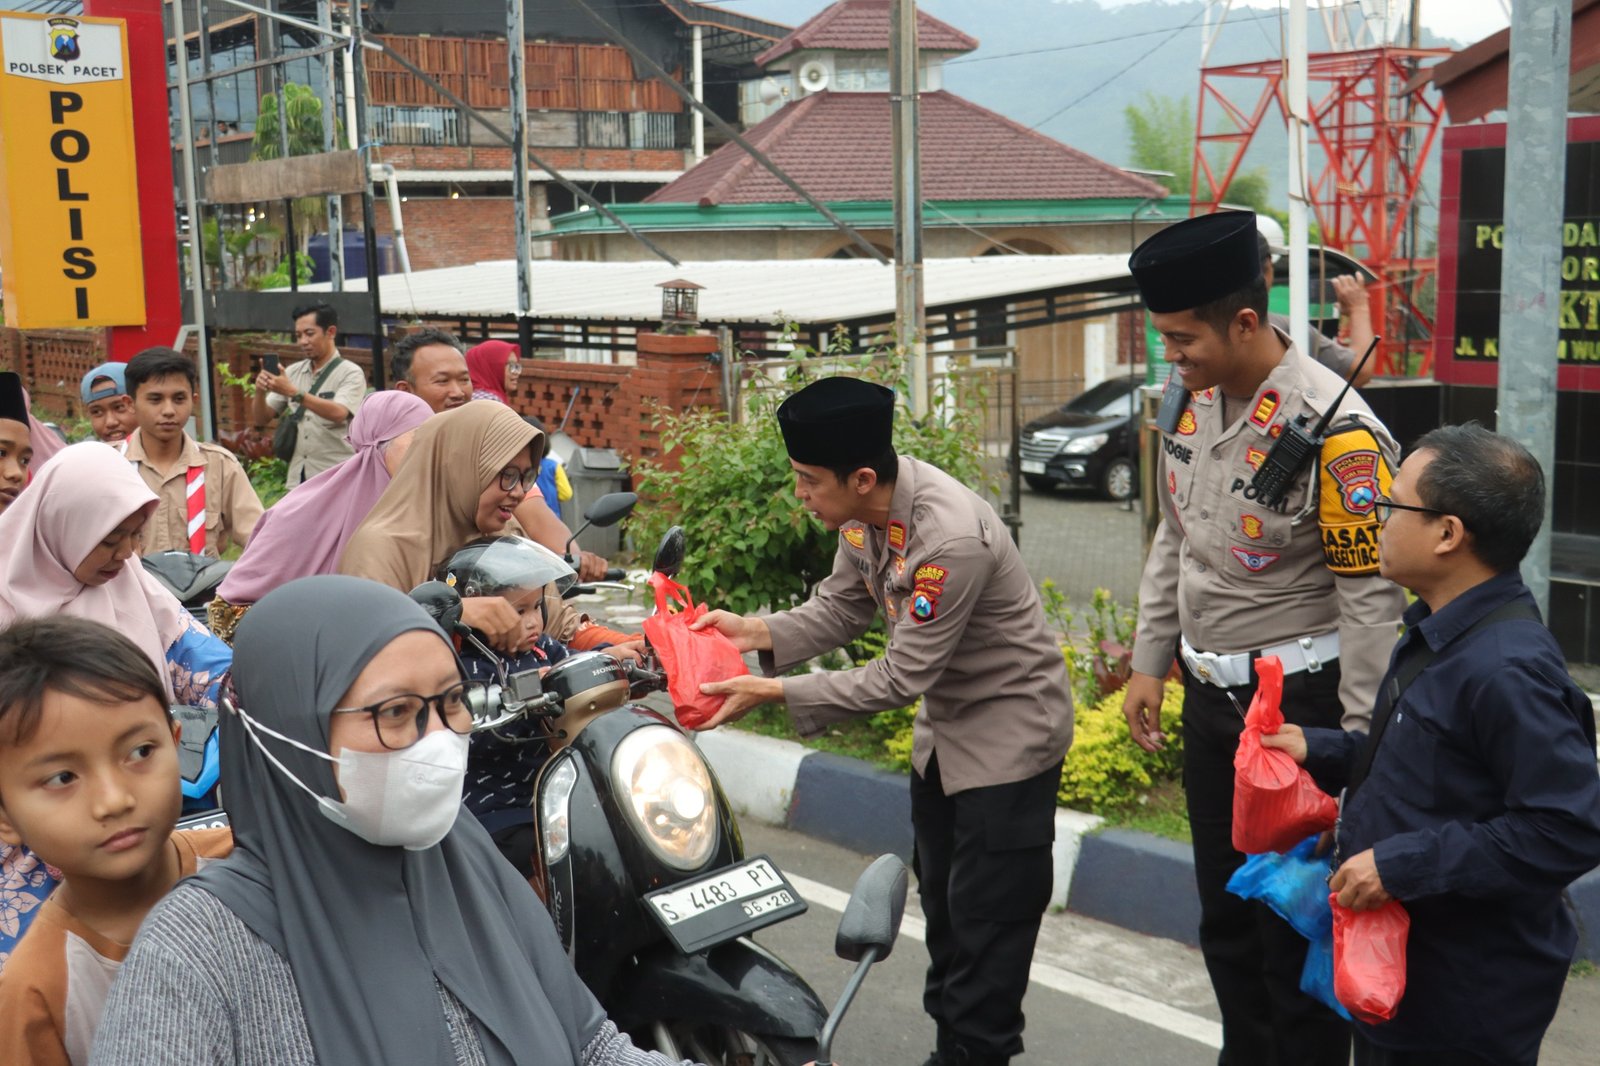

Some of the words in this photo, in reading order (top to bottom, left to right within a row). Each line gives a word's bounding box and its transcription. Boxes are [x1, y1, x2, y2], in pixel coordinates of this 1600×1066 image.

[10, 63, 64, 75] POLSEK
[73, 66, 117, 77] PACET
[49, 90, 97, 319] POLISI
[661, 903, 679, 921] S
[690, 881, 737, 909] 4483
[747, 864, 773, 887] PT
